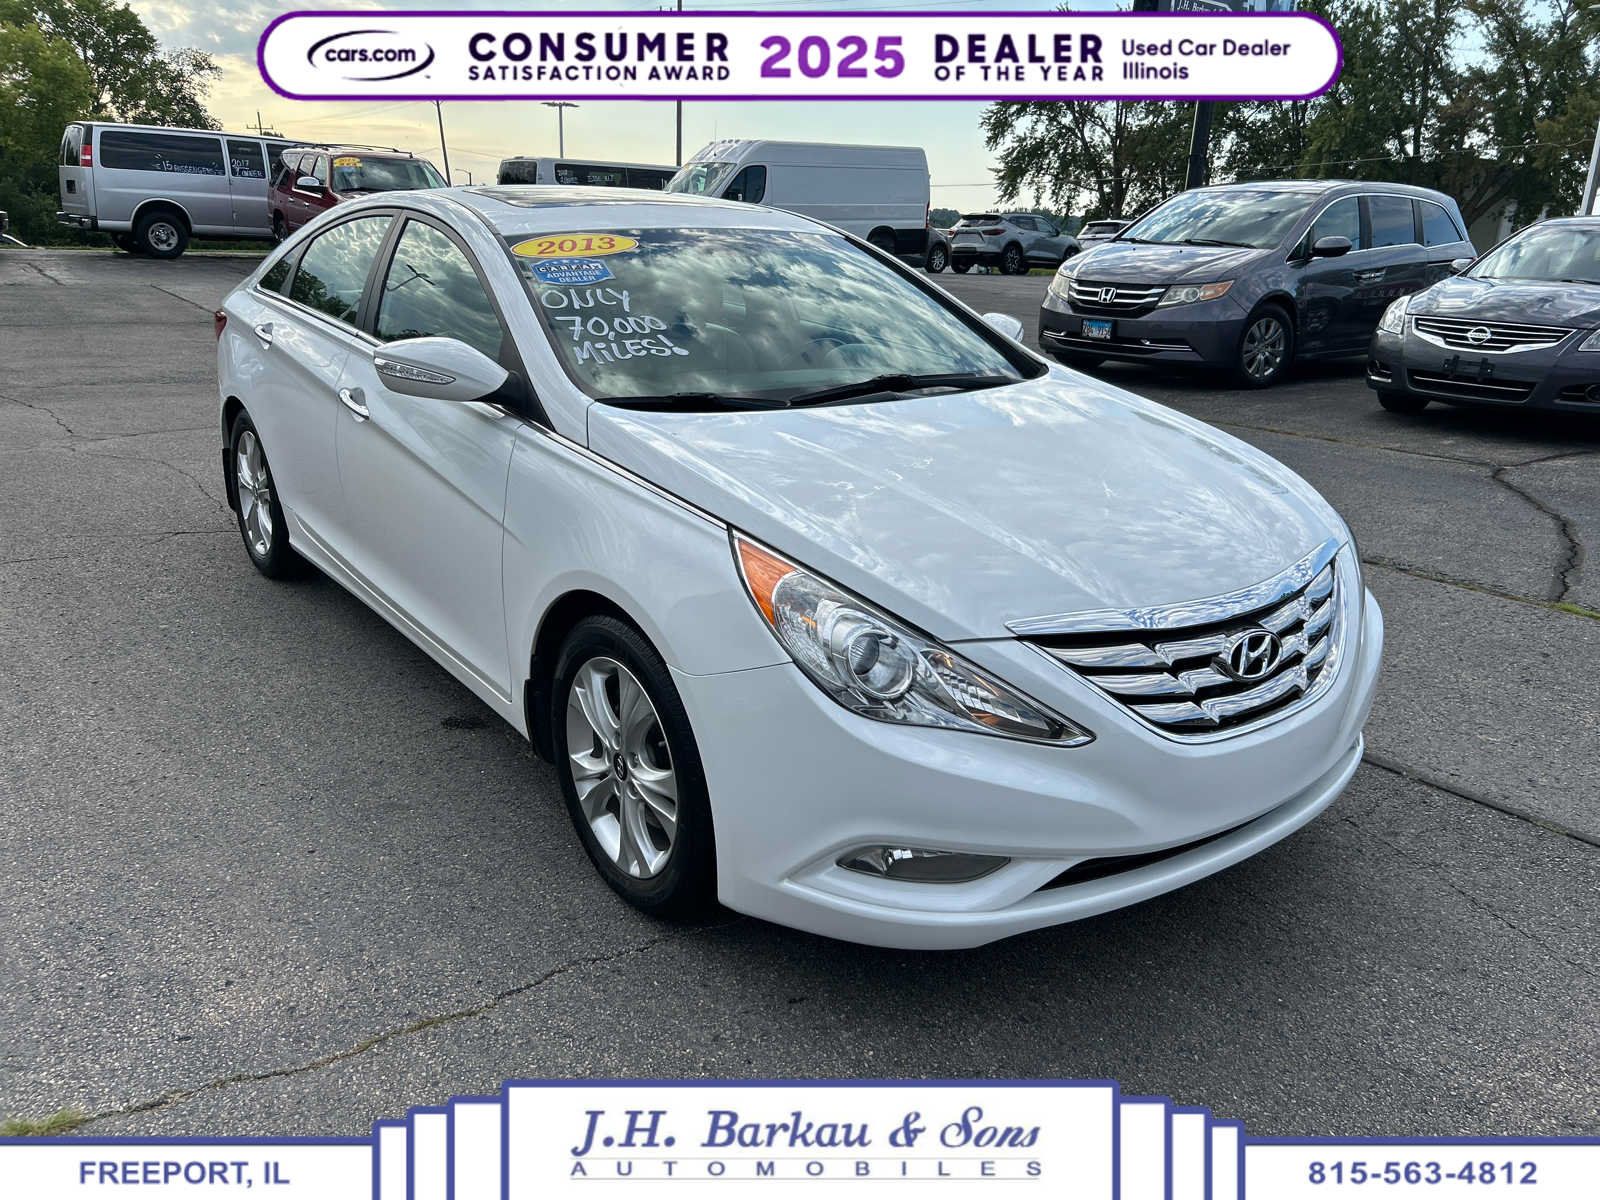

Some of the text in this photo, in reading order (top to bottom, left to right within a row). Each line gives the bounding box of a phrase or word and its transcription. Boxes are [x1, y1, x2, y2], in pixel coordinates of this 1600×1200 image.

[538, 237, 615, 255] 2013
[538, 263, 604, 273] CARFAX
[541, 287, 630, 312] ONLY
[554, 315, 668, 341] 70,000
